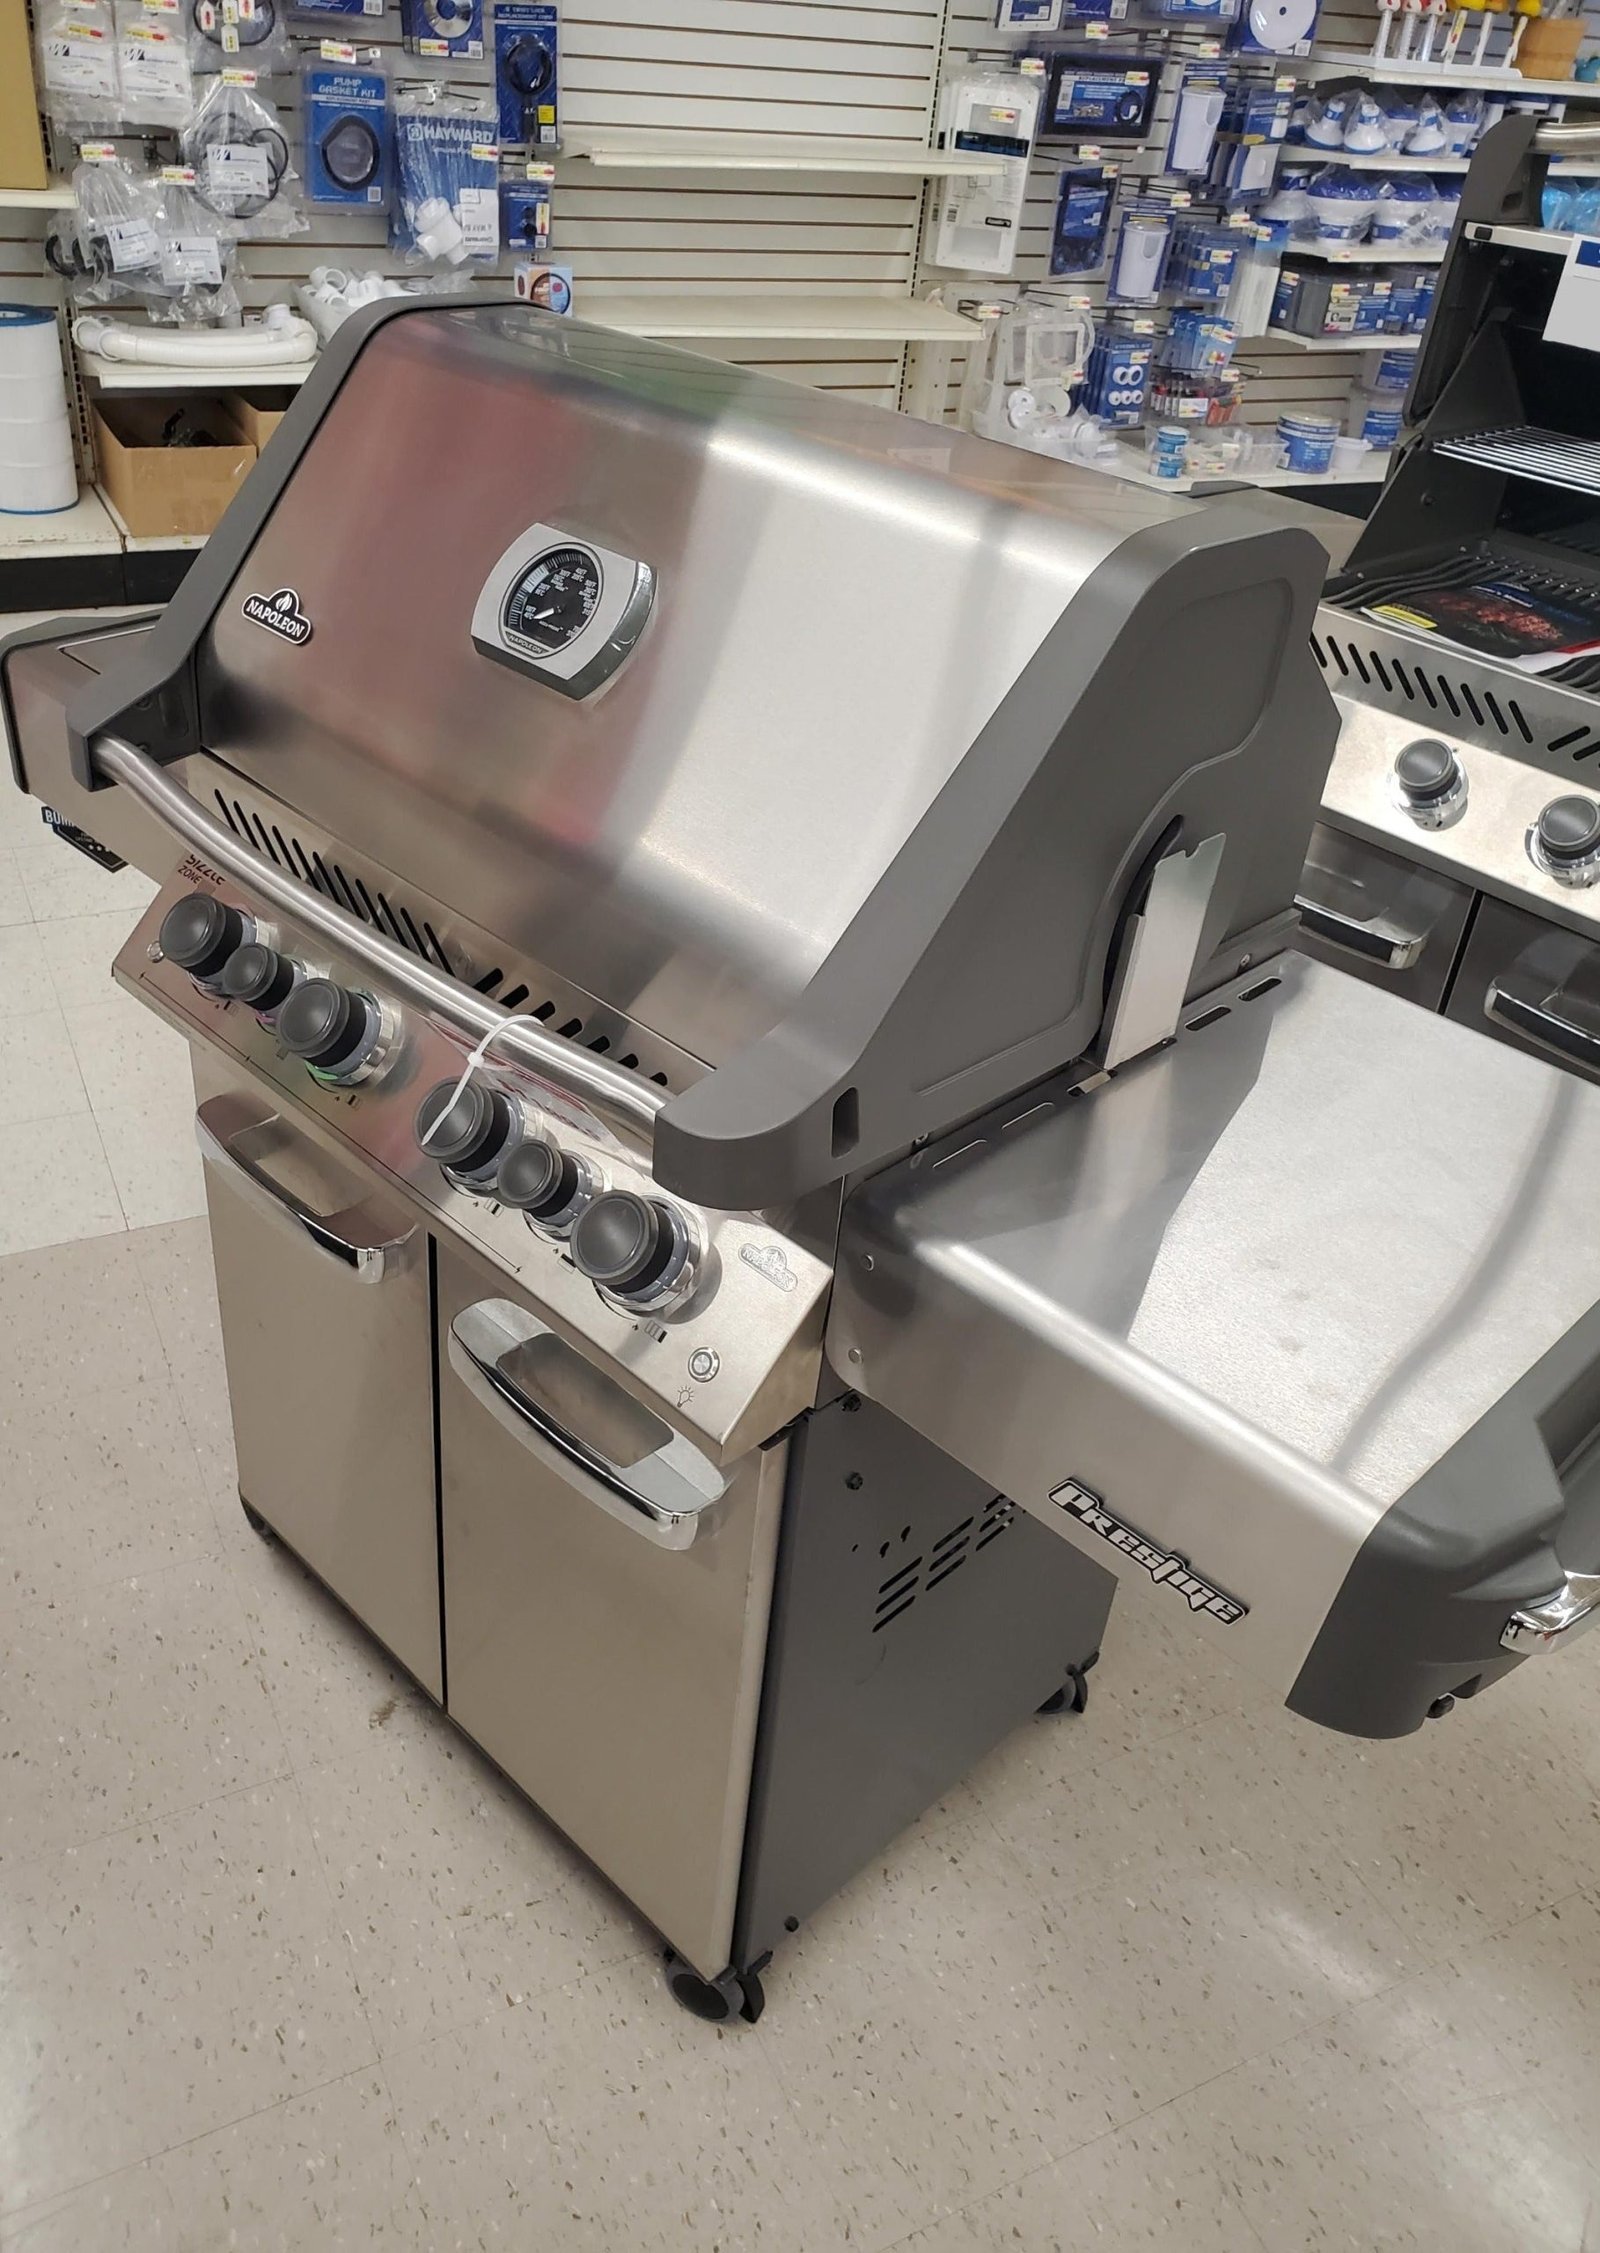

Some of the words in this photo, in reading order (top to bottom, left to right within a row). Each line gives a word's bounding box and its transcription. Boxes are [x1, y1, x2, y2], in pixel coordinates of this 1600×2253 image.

[319, 85, 358, 96] GASKET
[361, 89, 376, 98] KIT
[334, 77, 362, 87] PUMP
[424, 125, 493, 144] HAYWARD
[246, 599, 306, 638] NAPOLEON
[509, 635, 542, 654] NAPOLEON
[178, 865, 202, 884] ZONE
